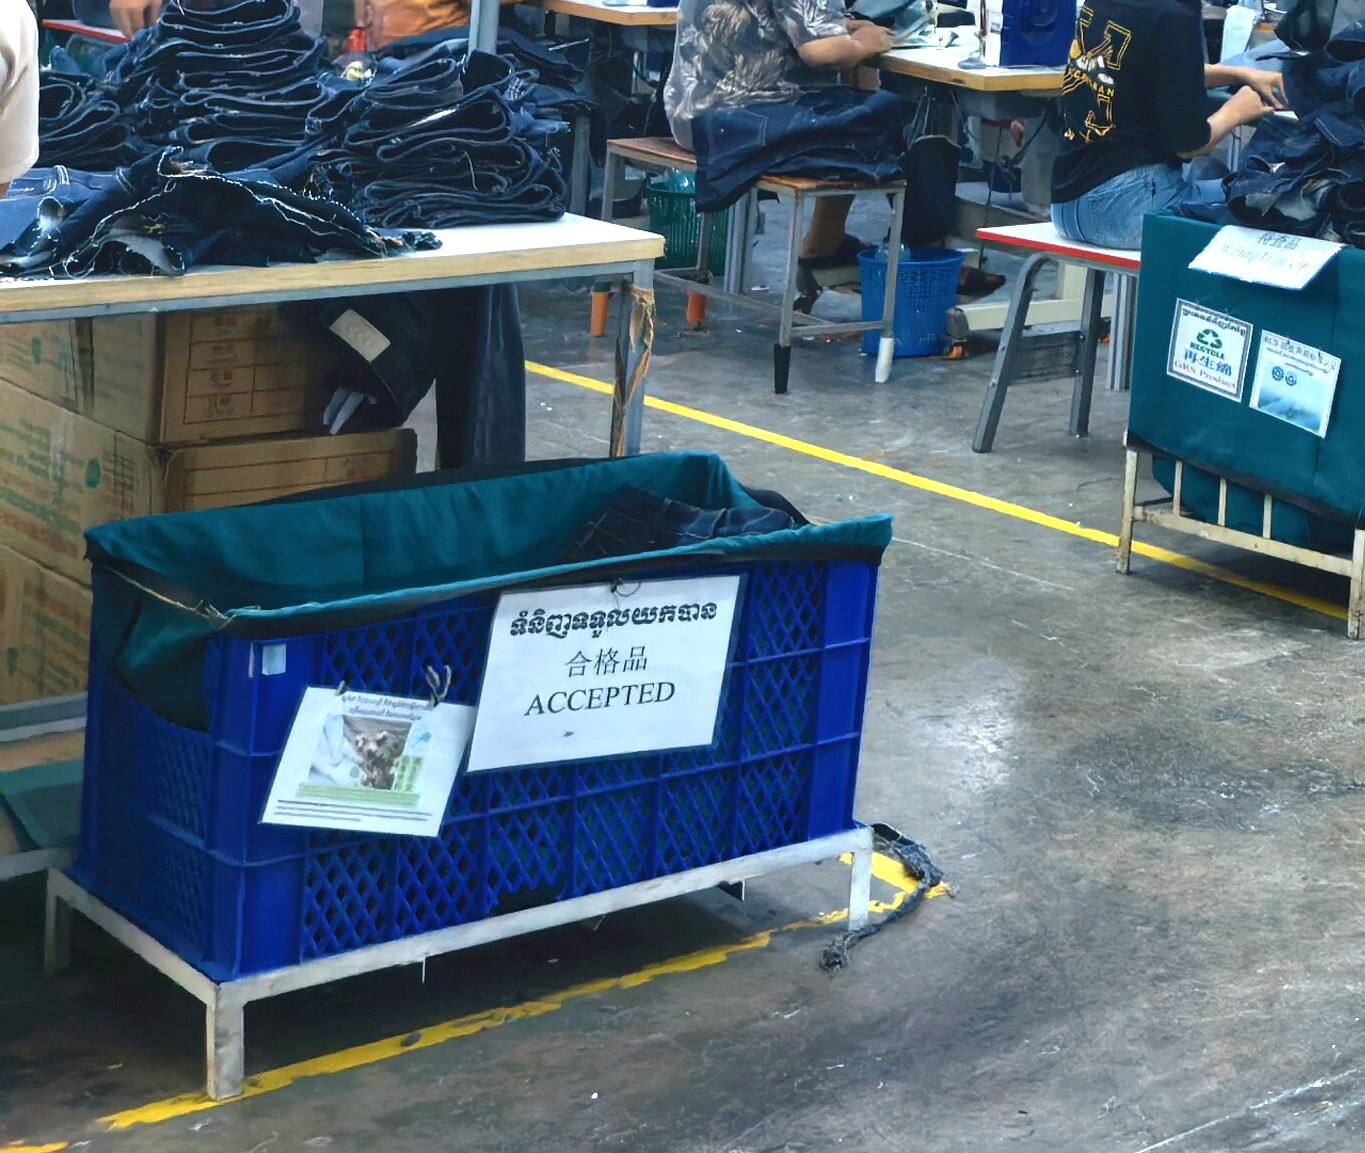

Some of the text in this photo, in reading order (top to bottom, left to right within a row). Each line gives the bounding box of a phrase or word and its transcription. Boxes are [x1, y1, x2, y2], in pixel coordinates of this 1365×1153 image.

[565, 645, 648, 678] 合格品
[524, 681, 676, 716] ACCEPTED
